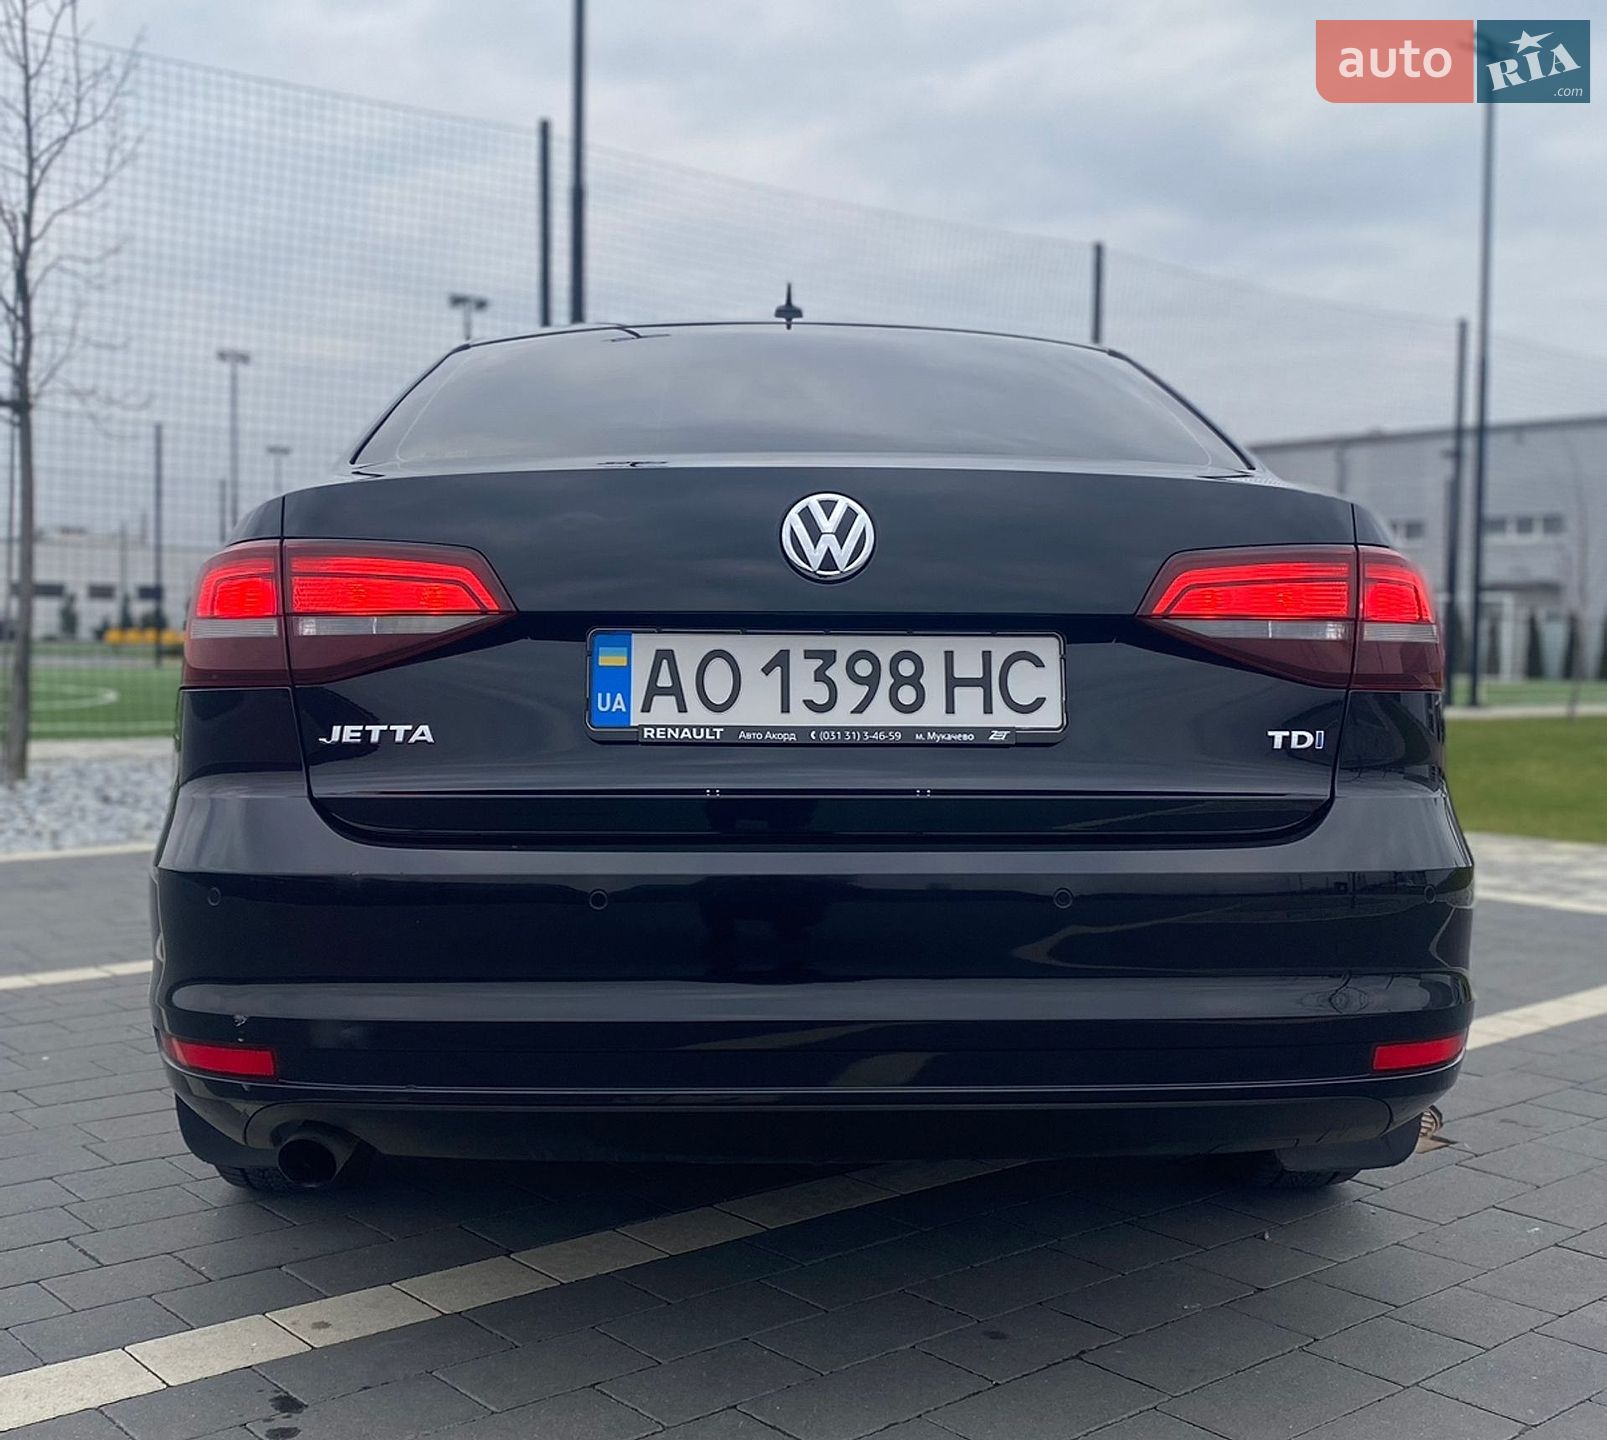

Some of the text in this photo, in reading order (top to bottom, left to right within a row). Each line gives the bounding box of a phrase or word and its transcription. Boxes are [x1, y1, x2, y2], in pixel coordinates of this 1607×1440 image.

[640, 648, 1047, 715] AO 1398 HC
[597, 693, 626, 712] UA
[318, 725, 435, 744] JETTA
[643, 727, 724, 740] RENAULT
[738, 730, 797, 742] Авто Акорд
[818, 730, 902, 741] (031 31) 3-46-59
[915, 731, 975, 742] м. Мукачево
[1267, 730, 1325, 750] TDI
